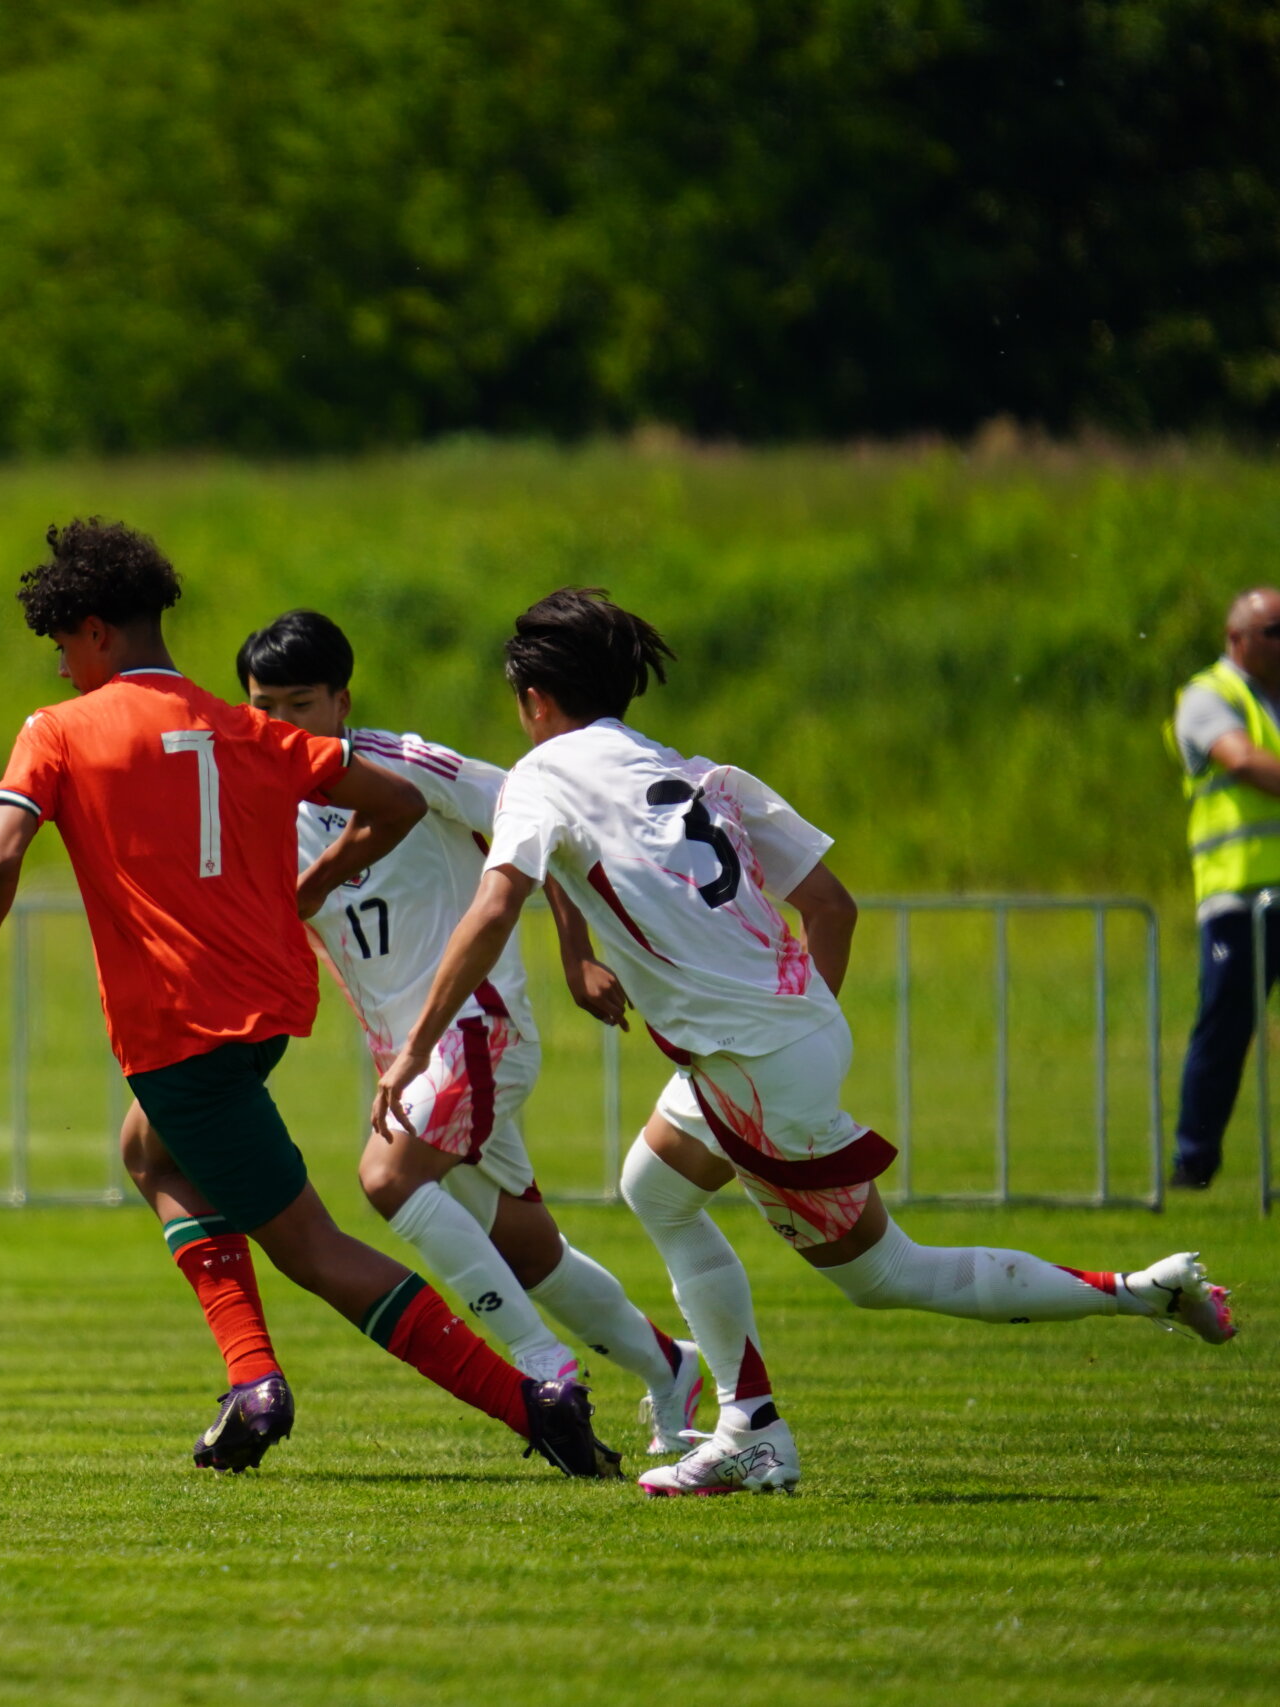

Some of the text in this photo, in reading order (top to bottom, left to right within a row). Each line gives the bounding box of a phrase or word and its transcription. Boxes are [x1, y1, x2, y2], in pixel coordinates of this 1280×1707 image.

[161, 730, 221, 879] 7
[646, 779, 741, 910] 3
[345, 897, 389, 960] 17
